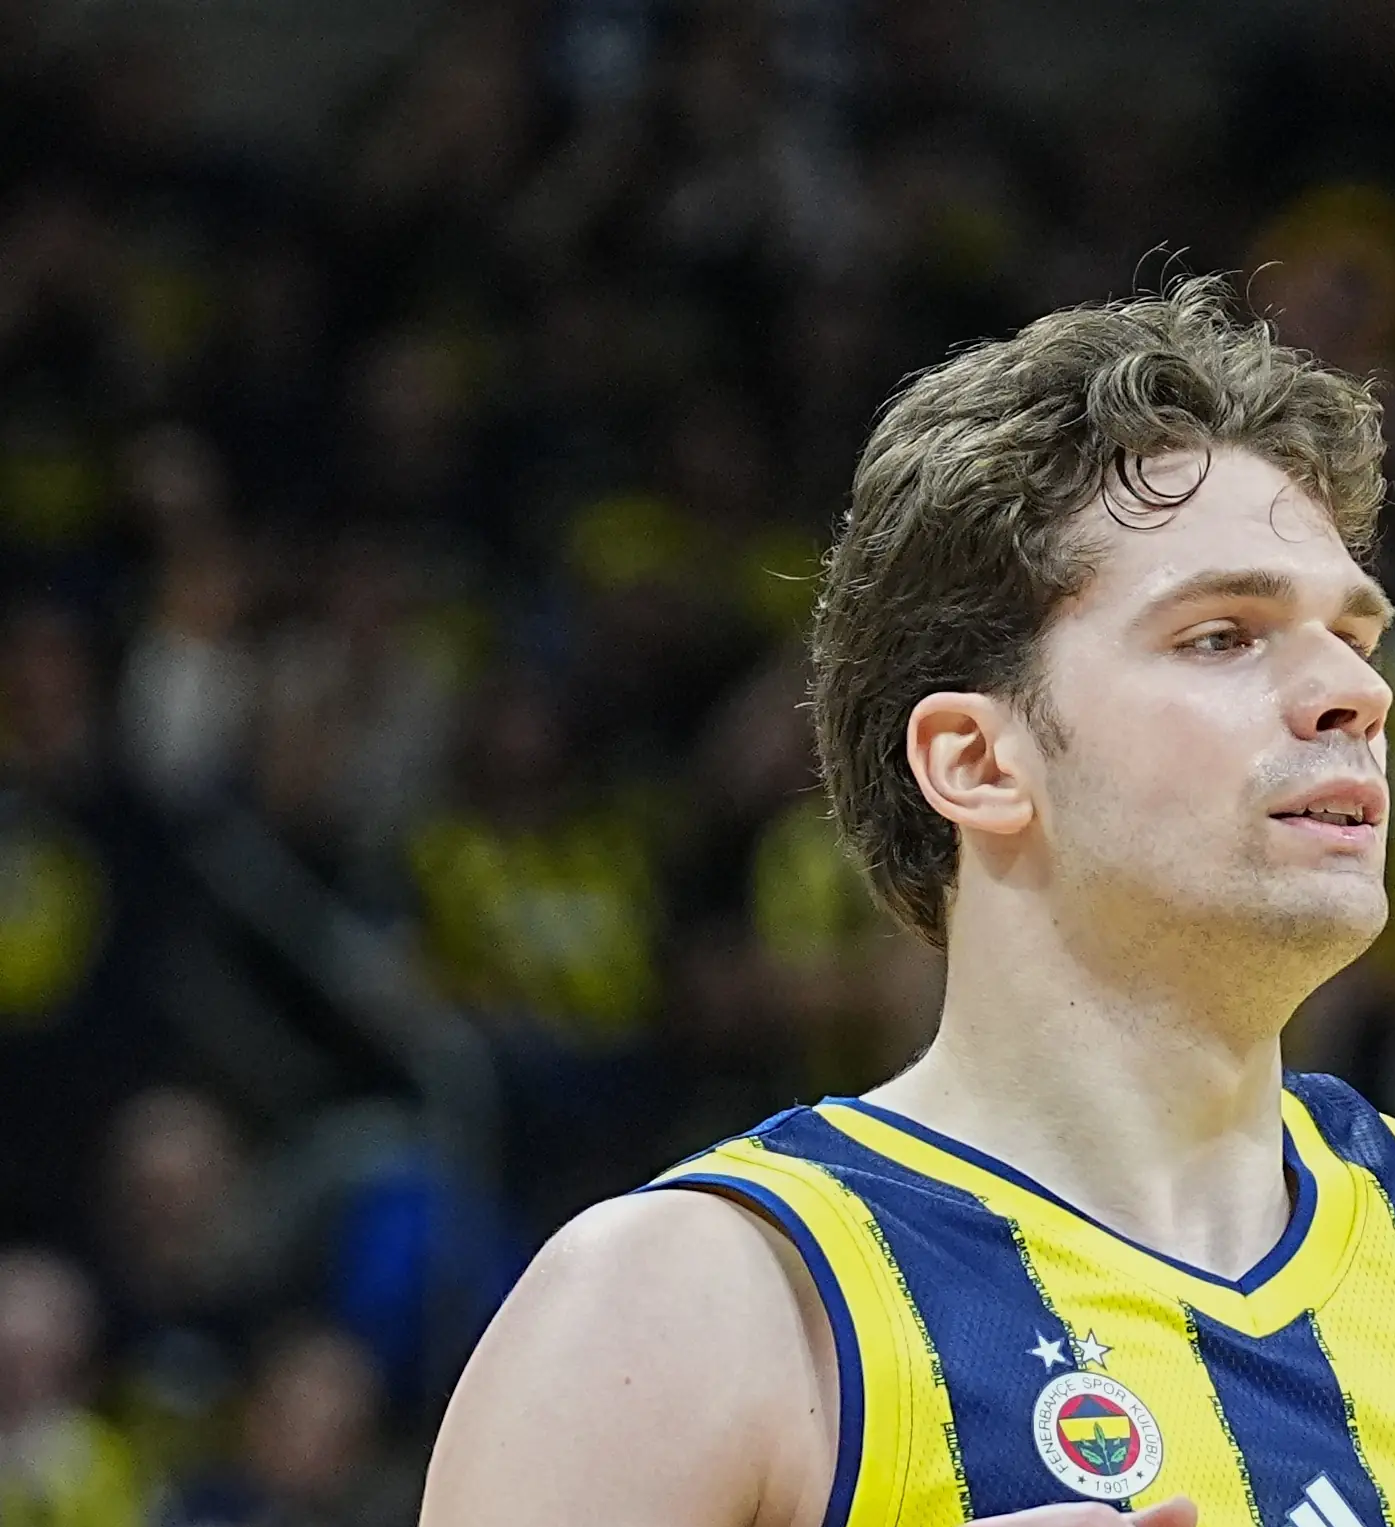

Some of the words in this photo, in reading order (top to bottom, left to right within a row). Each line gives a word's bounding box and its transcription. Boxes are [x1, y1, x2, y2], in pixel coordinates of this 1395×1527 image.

[1039, 1379, 1076, 1475] FENERBAHÇE
[1082, 1377, 1126, 1402] SPOR
[1129, 1403, 1160, 1467] KULÜBÜ
[1095, 1478, 1129, 1495] 1907
